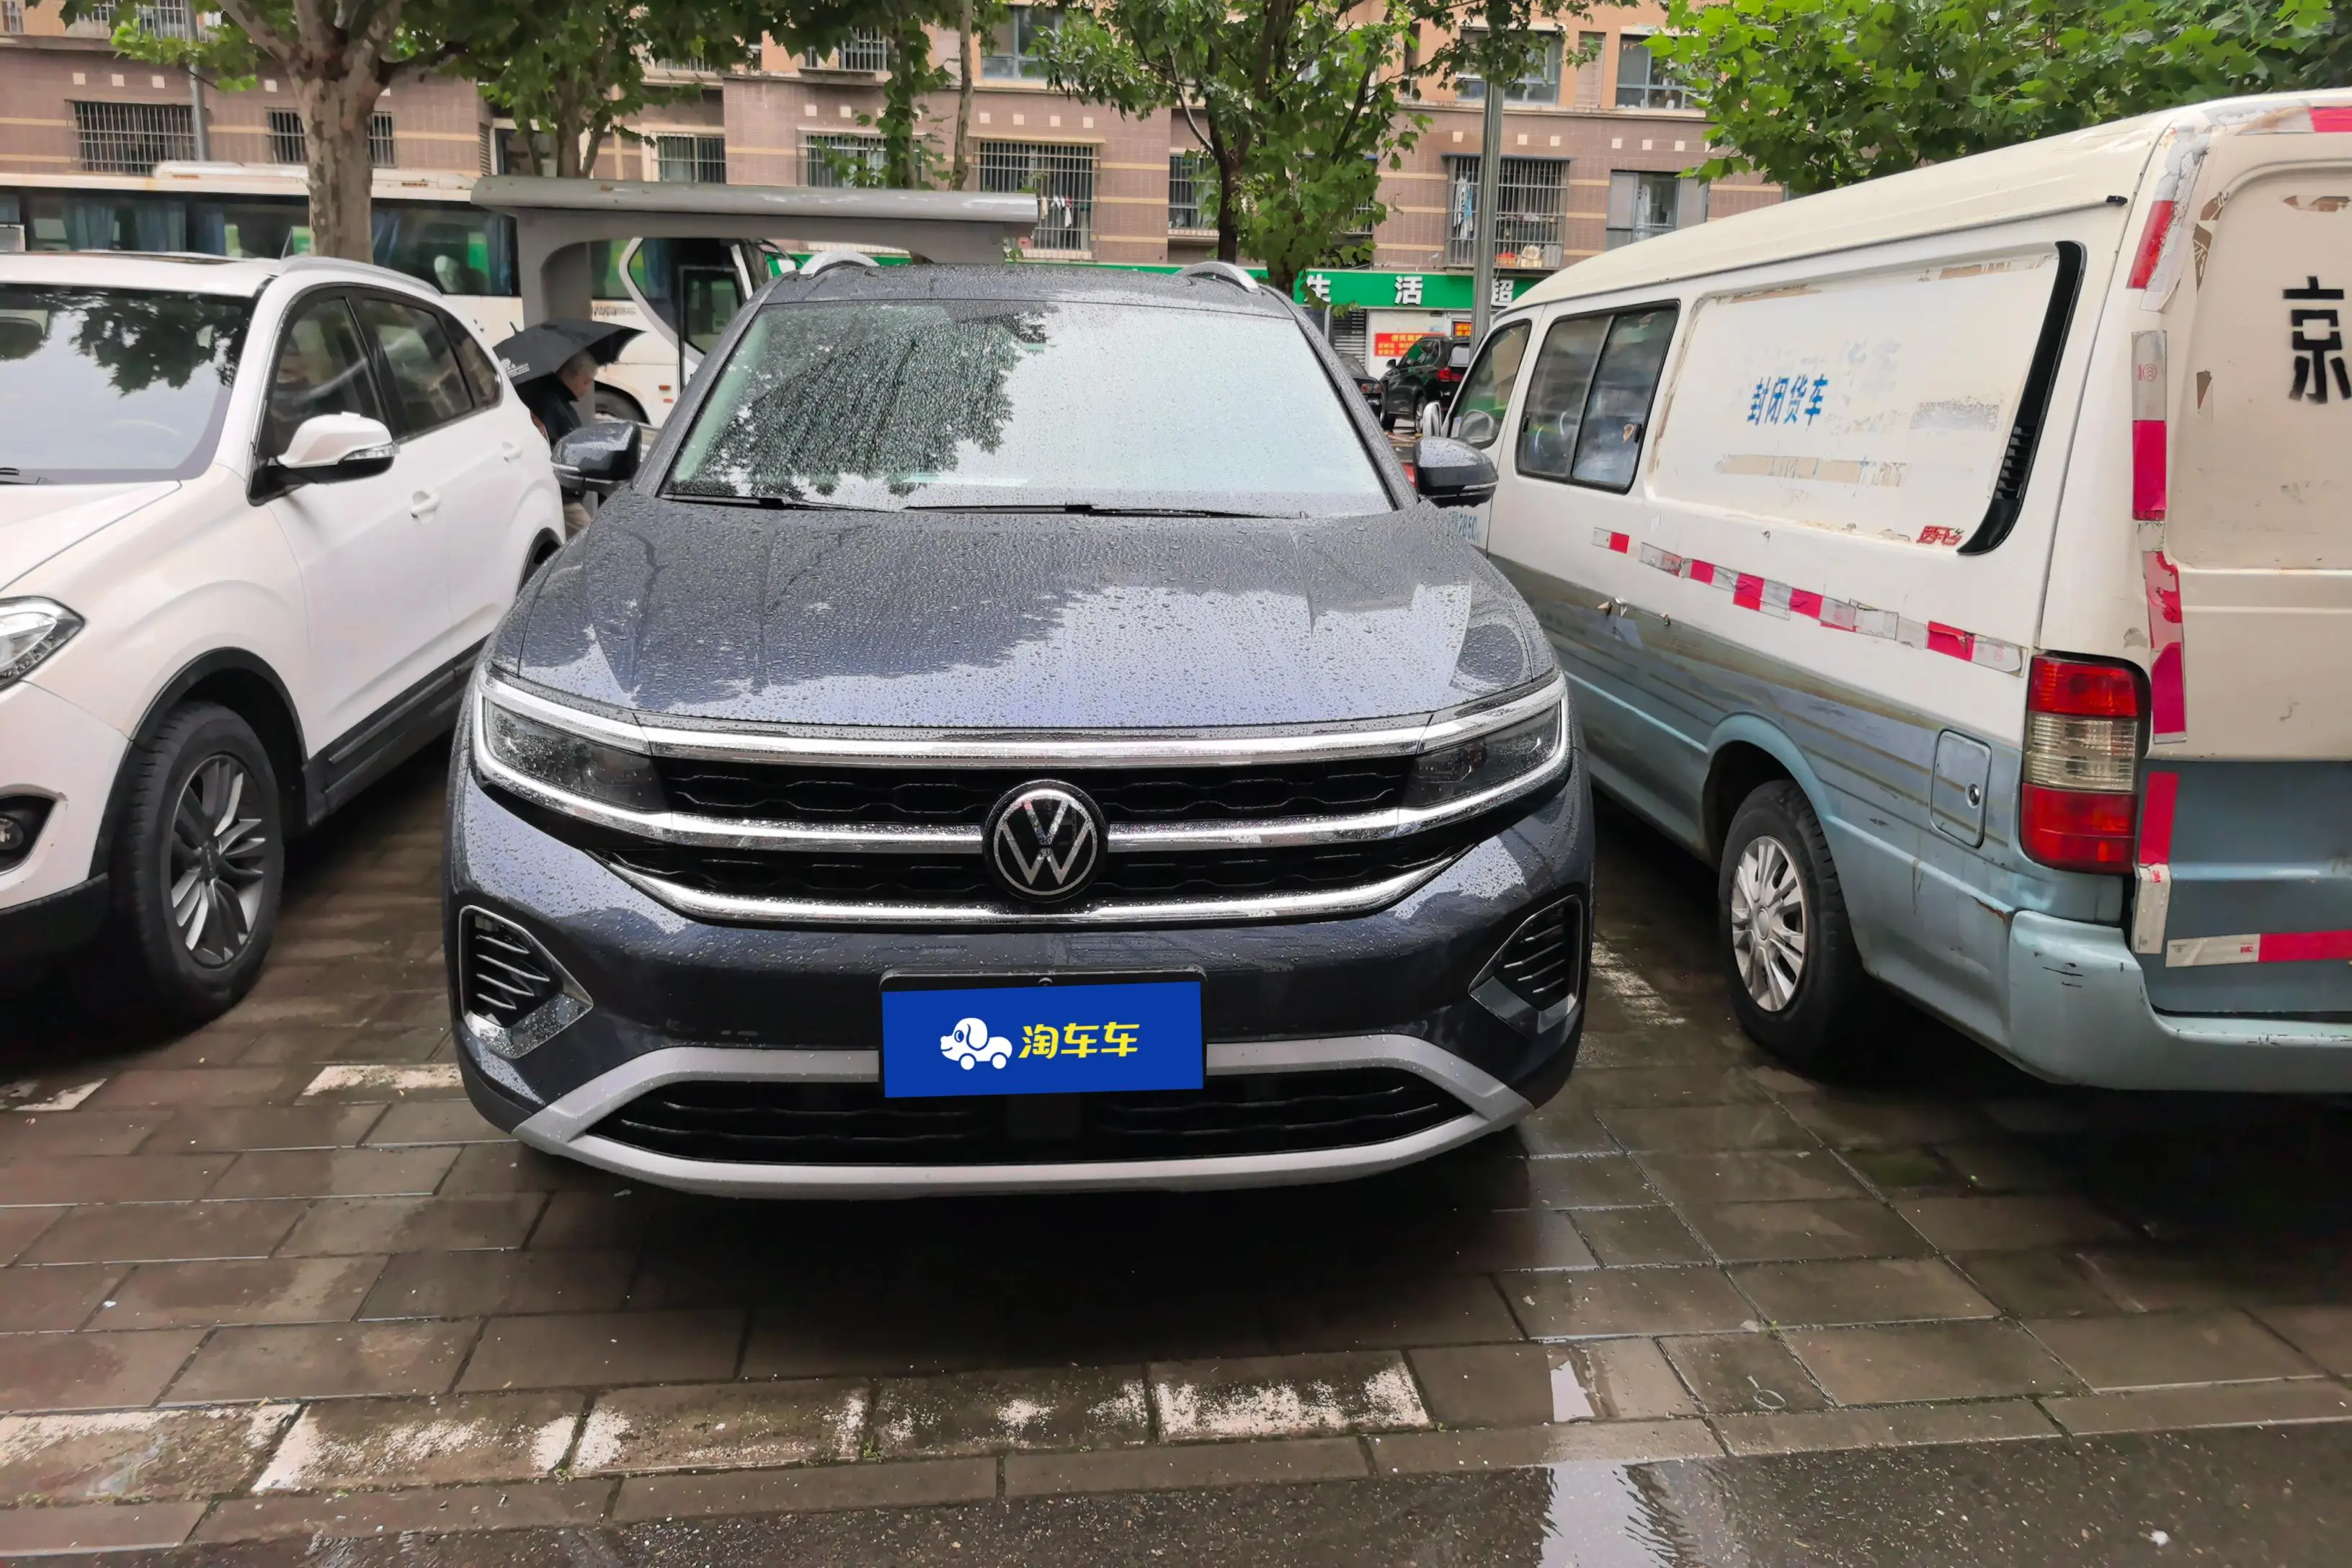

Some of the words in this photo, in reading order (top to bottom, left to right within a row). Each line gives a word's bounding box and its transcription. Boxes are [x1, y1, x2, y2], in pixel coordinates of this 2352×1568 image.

[2282, 275, 2352, 404] 京
[1747, 373, 1829, 426] 封闭货车
